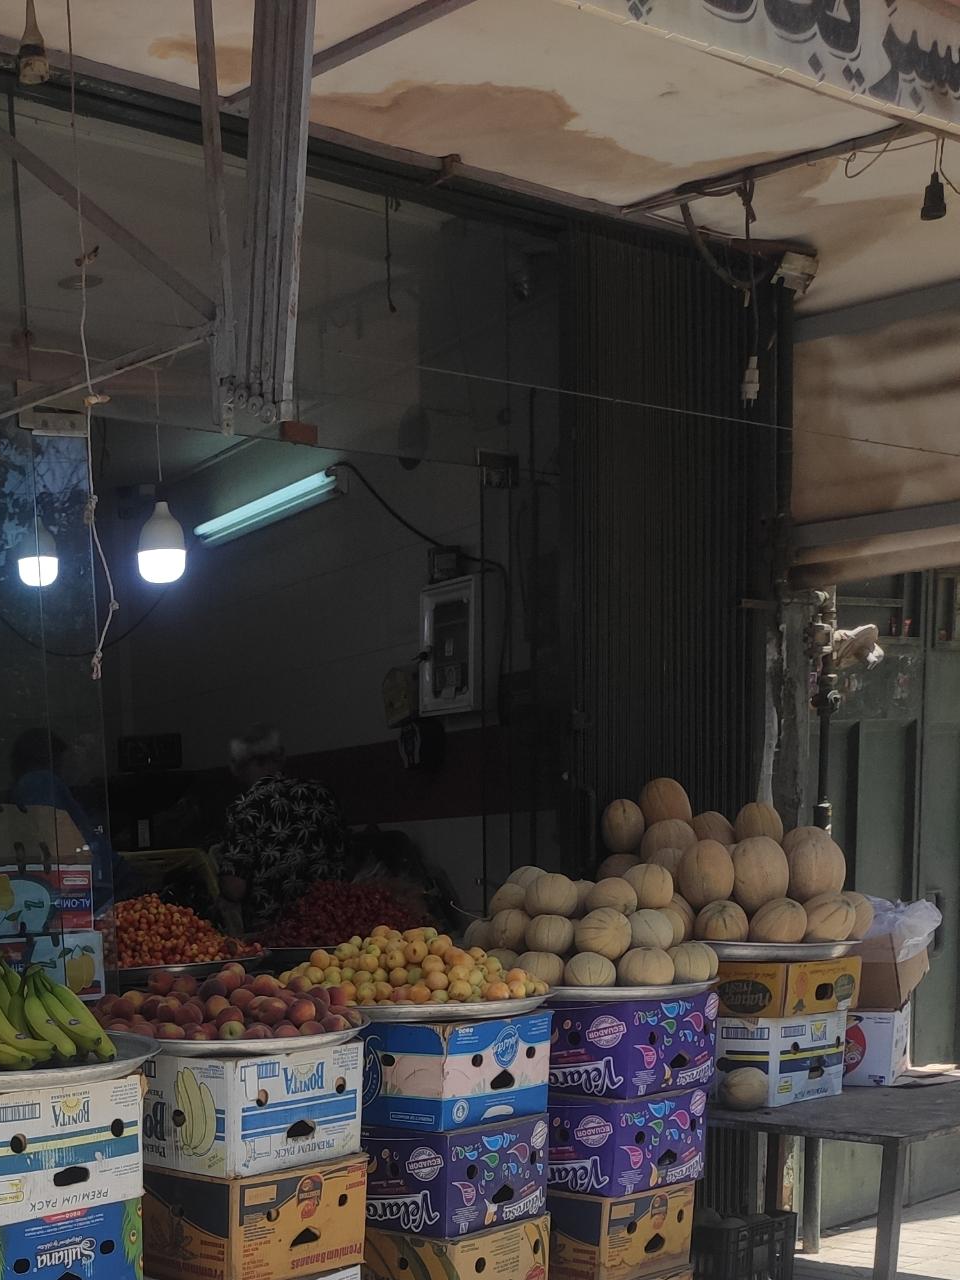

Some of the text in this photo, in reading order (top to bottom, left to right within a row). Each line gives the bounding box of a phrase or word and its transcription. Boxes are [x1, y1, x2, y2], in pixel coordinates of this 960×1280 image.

[589, 1026, 624, 1037] ECUADOR
[282, 1062, 324, 1095] BONITA
[52, 1100, 90, 1128] BONITA
[577, 1126, 610, 1136] ECUADOR
[274, 1139, 334, 1159] PREMIUM PACK
[408, 1157, 441, 1170] ECUADOR
[30, 1198, 57, 1212] PACK
[63, 1188, 108, 1204] PREMIUM
[37, 1238, 95, 1269] Sultana
[291, 1243, 362, 1269] Premium Bananas
